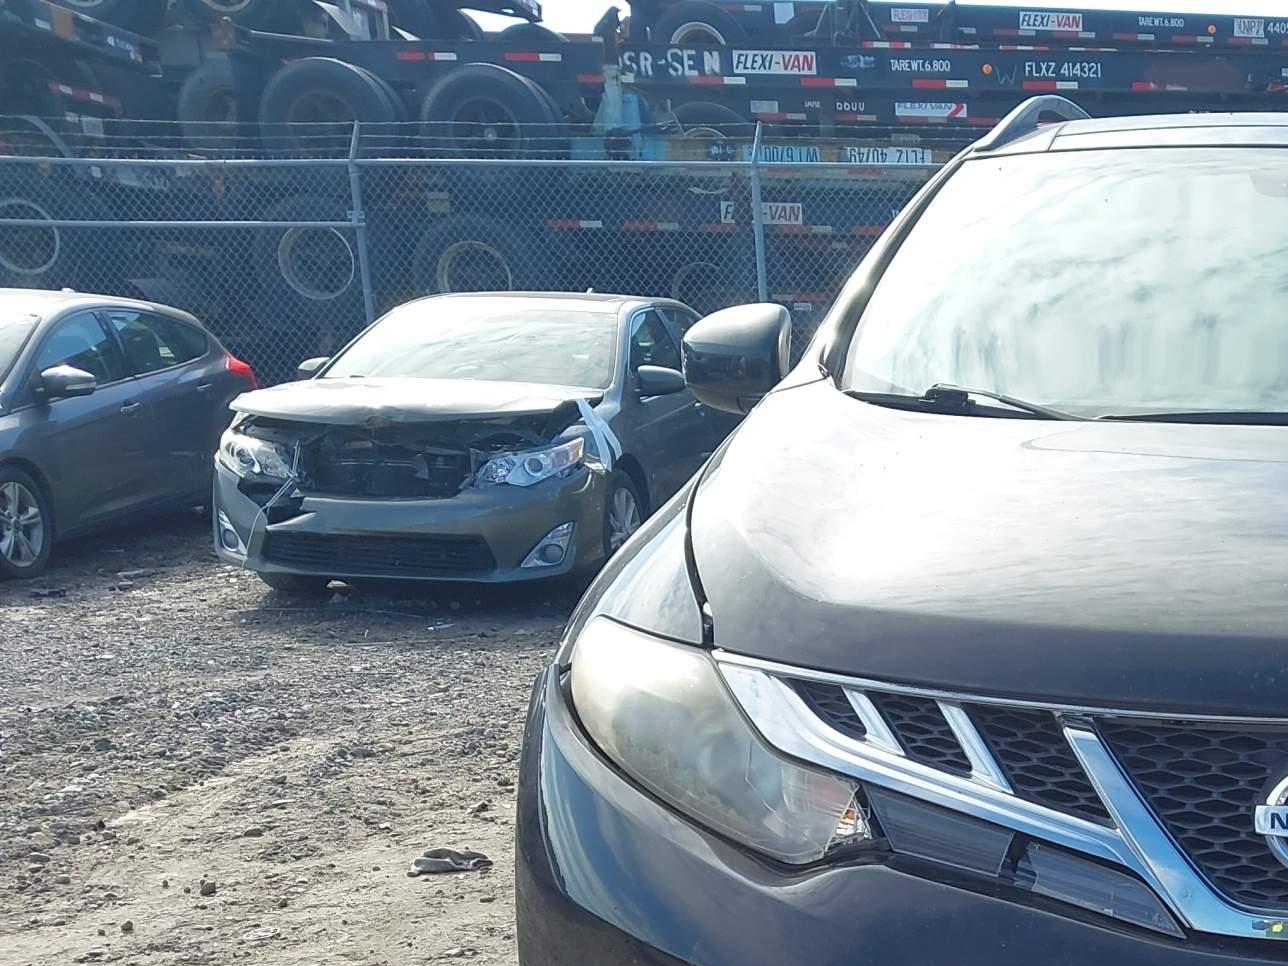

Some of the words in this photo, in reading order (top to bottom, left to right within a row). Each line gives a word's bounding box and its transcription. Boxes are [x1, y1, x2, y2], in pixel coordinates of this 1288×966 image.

[1020, 13, 1080, 29] FLEXI-VAN
[735, 53, 814, 71] FLEXI-VAN
[1025, 61, 1056, 77] FLXZ
[1060, 62, 1101, 78] 414321
